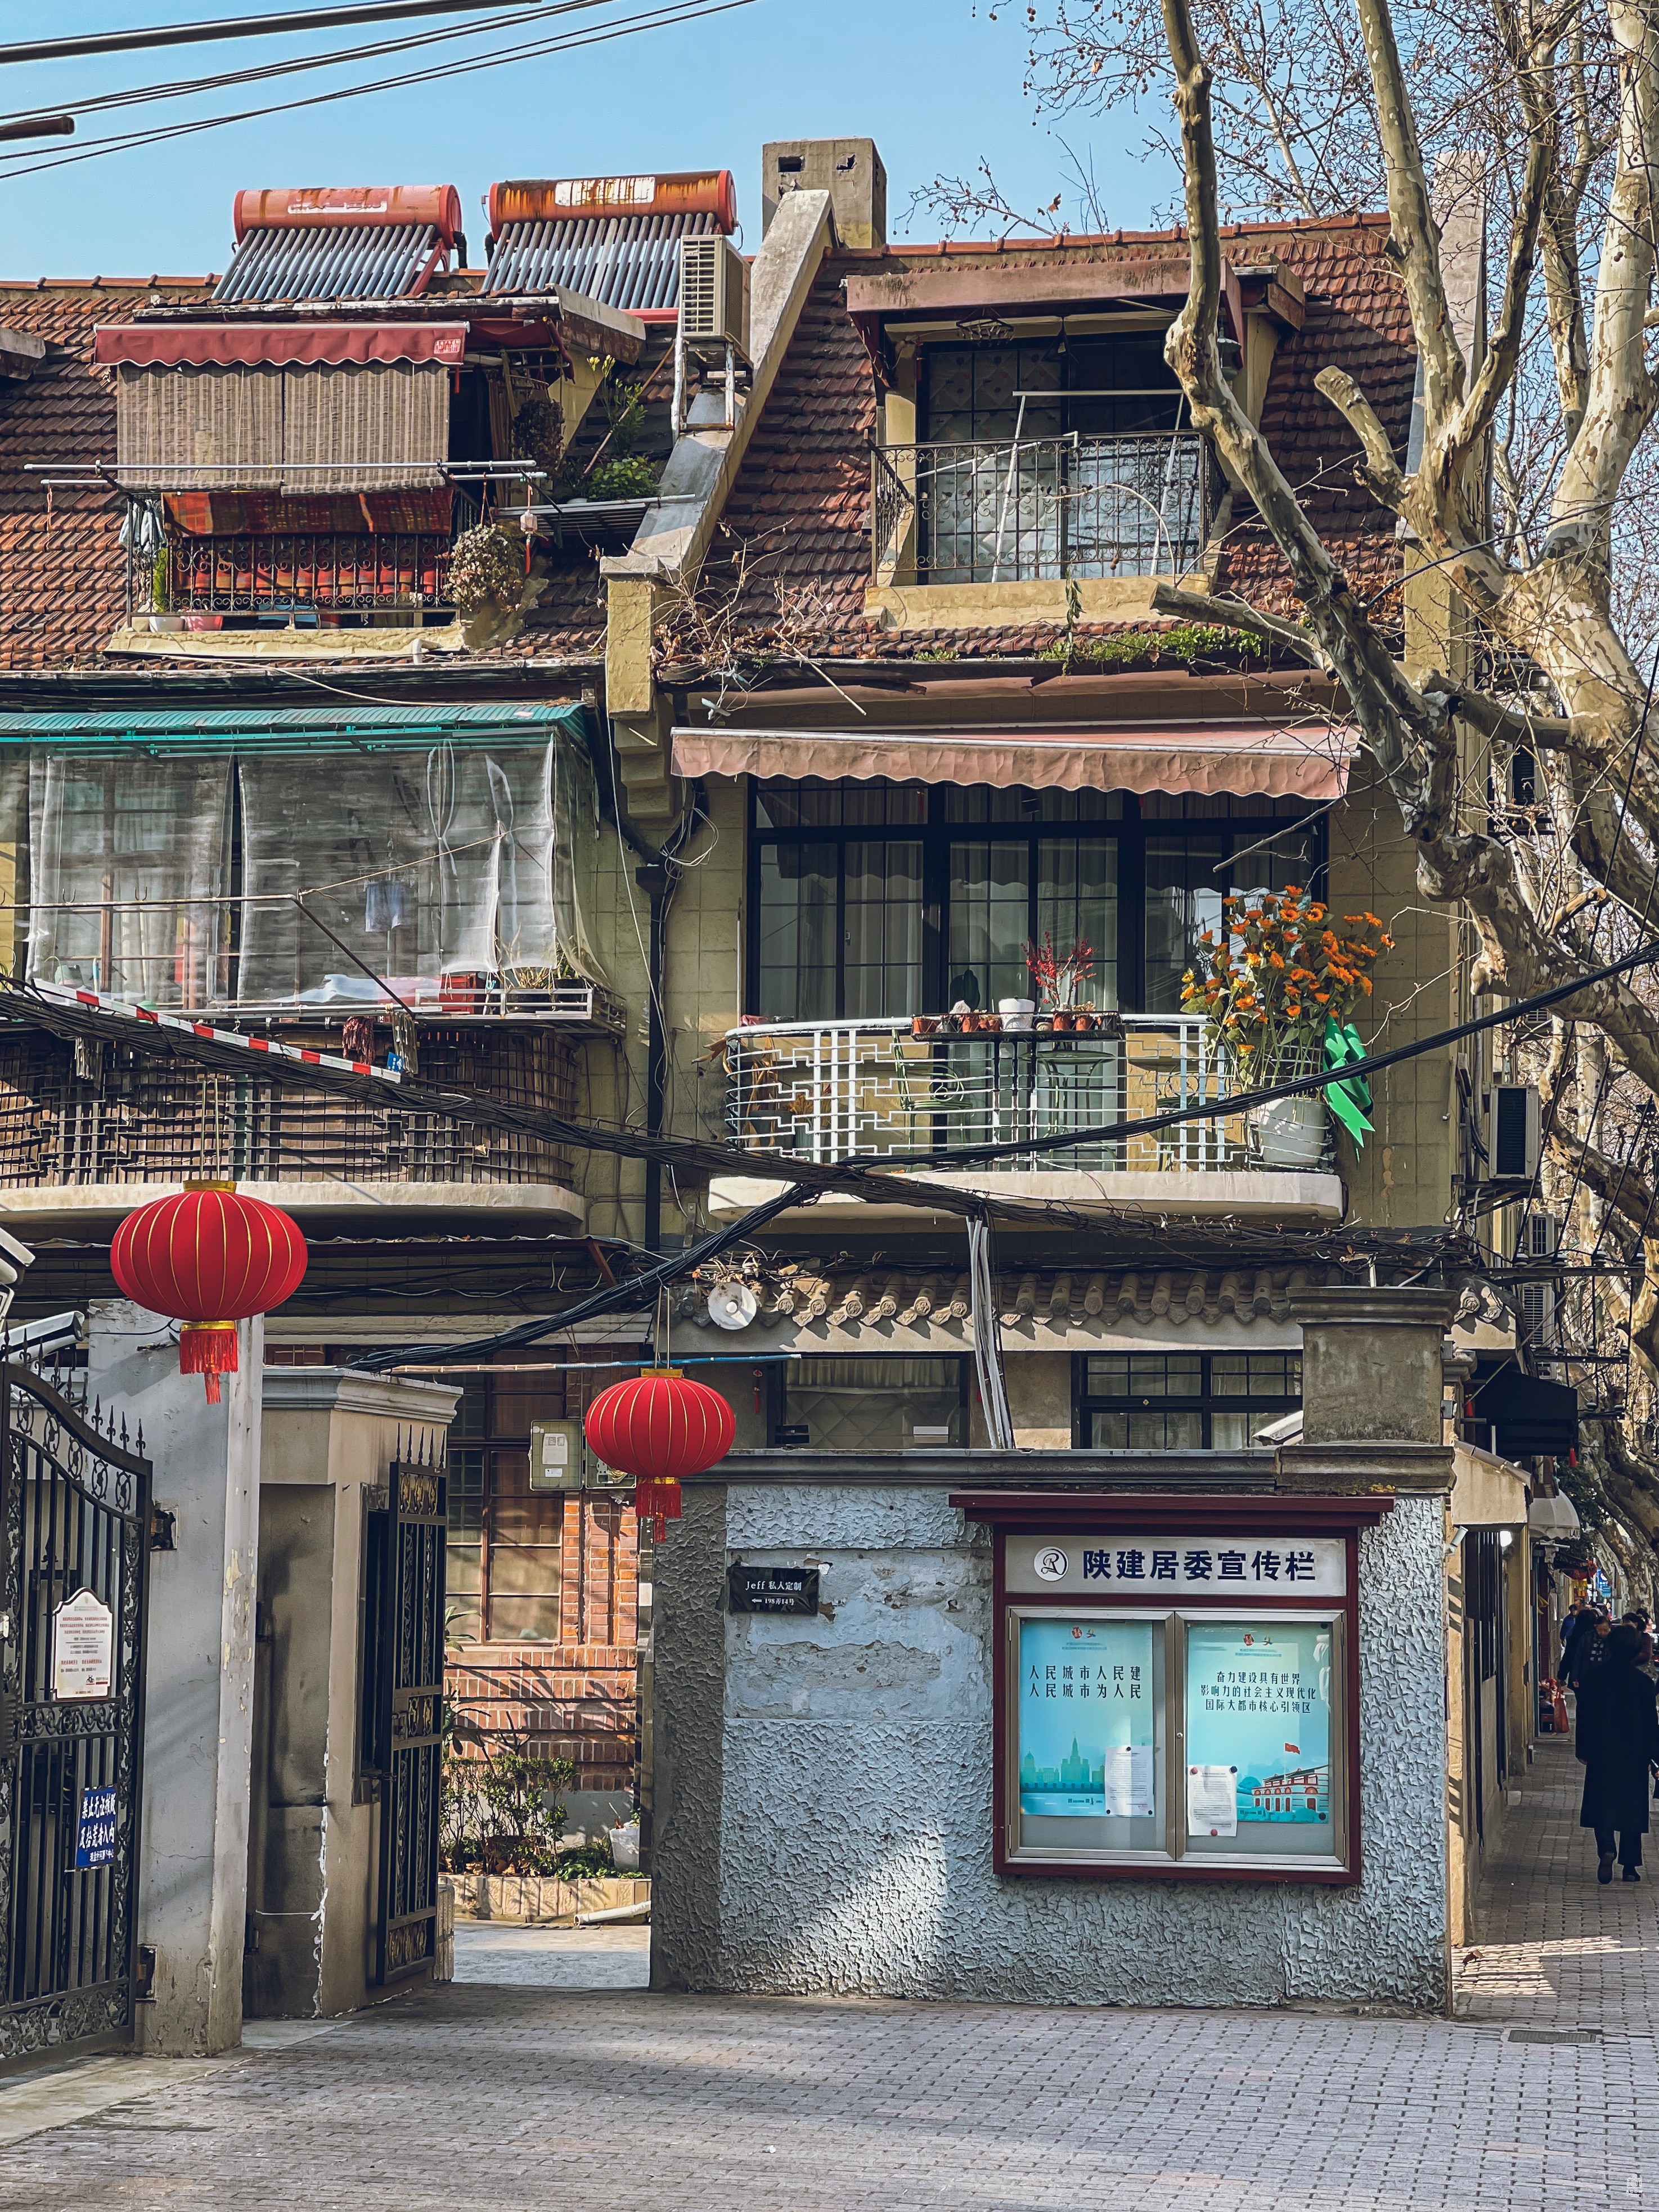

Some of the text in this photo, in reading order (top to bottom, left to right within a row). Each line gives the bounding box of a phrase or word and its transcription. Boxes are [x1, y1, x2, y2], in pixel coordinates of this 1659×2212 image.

[1083, 1549, 1315, 1580] 陕建居委宣传栏
[745, 1581, 802, 1591] Jeff 私人定制
[1029, 1665, 1140, 1681] 人民城市人民建
[1217, 1671, 1300, 1685] 奋力建设具有世界
[1029, 1683, 1141, 1699] 人民城市为人民
[1201, 1684, 1316, 1700] 影响力的社会主义现代化
[1206, 1698, 1311, 1714] 国际大都市核心引领区
[82, 1792, 116, 1819] 禁止无证摊贩
